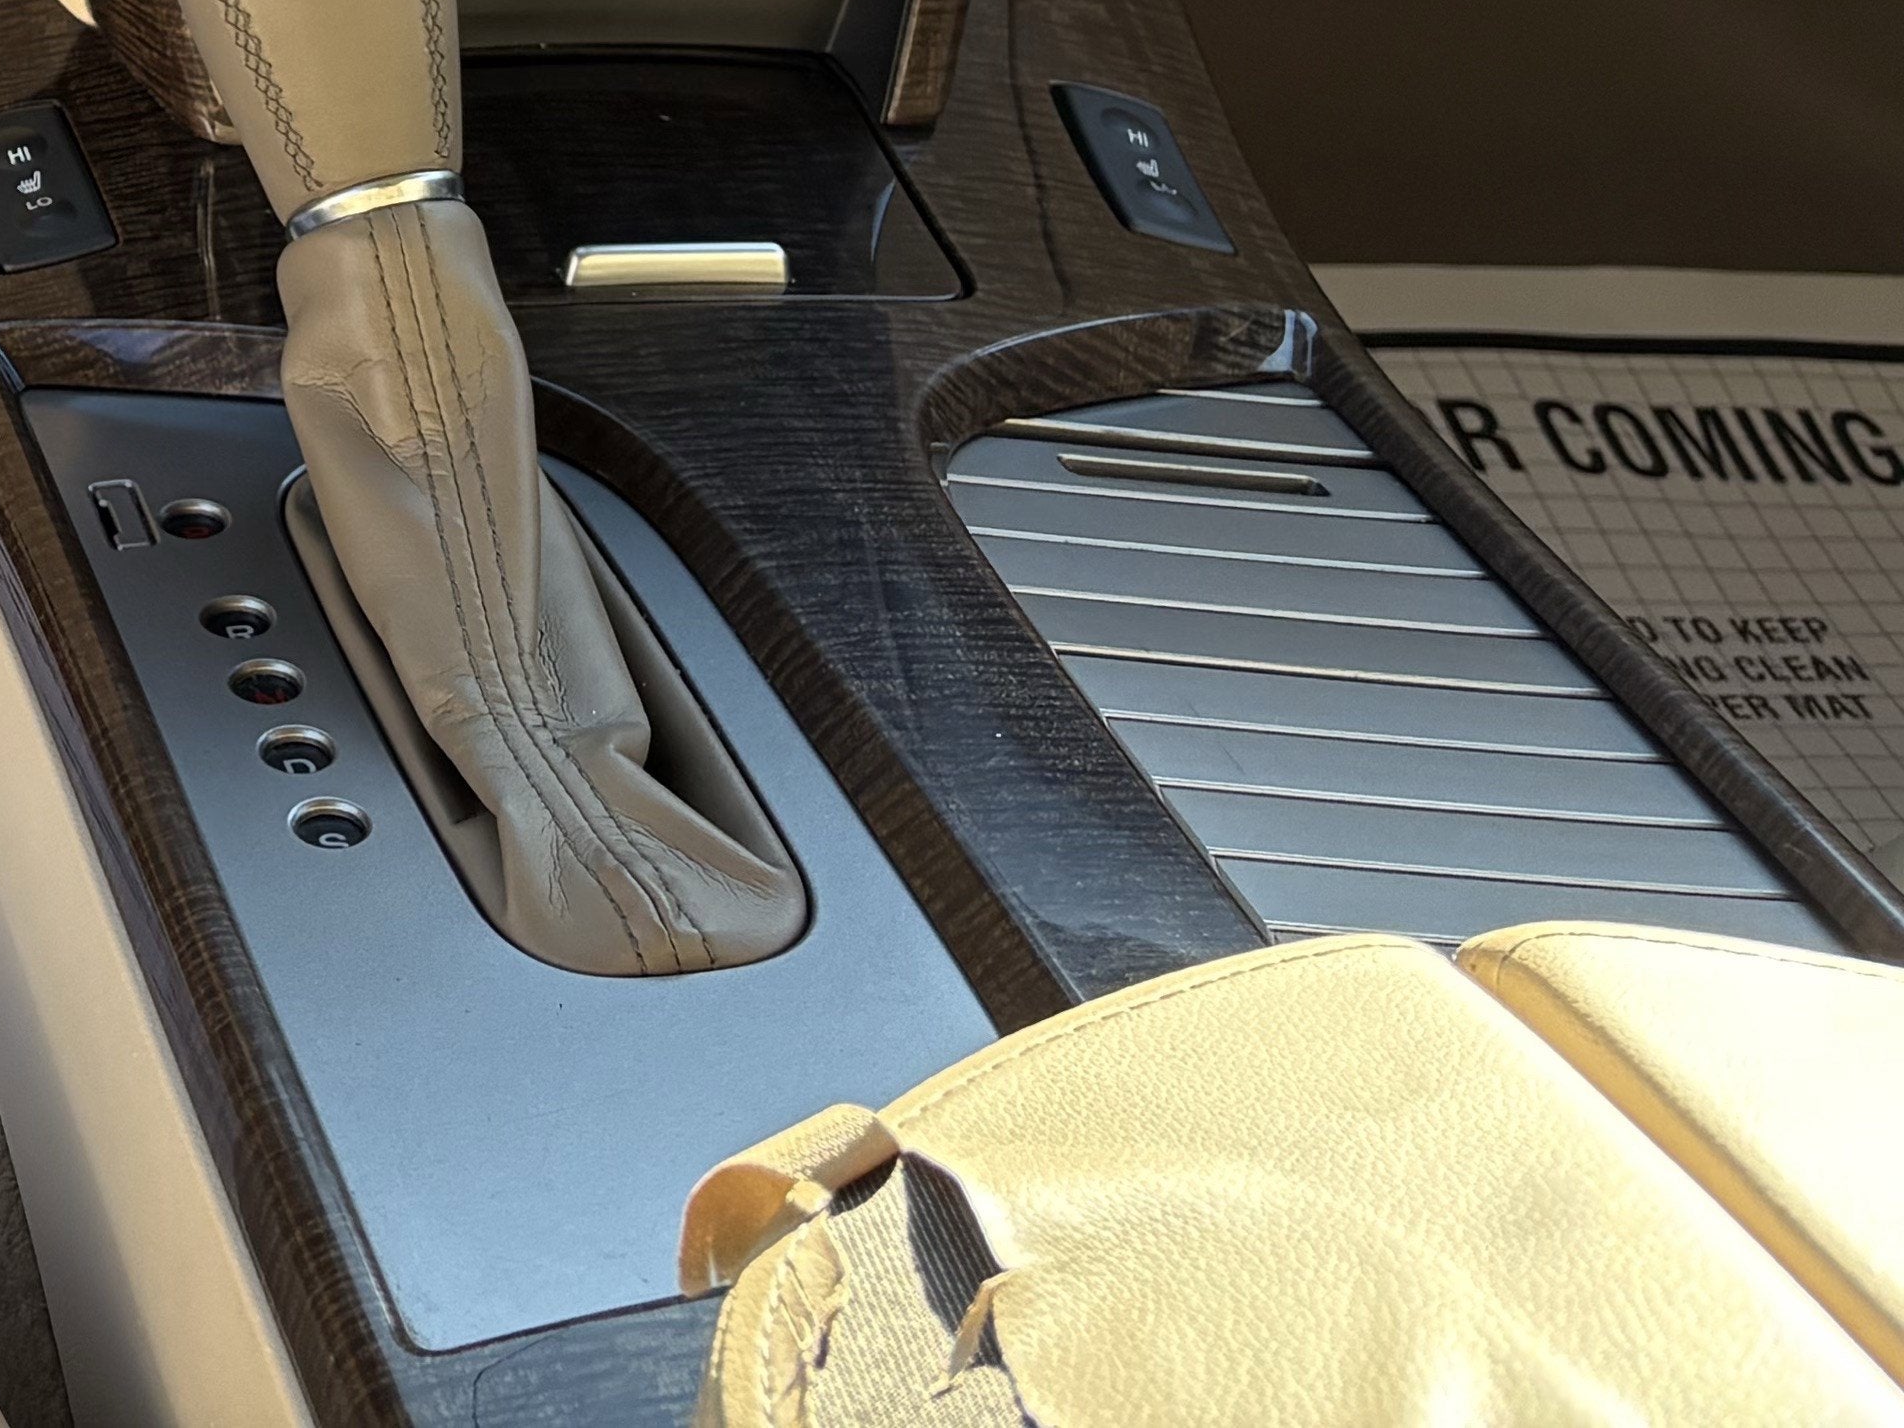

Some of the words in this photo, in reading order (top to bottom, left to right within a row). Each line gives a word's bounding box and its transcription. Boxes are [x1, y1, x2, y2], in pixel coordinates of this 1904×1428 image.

[1127, 128, 1149, 148] HI
[7, 146, 32, 166] HI
[26, 196, 53, 210] LO
[1533, 398, 1904, 486] COMING
[1663, 616, 1722, 643] TO
[1730, 616, 1828, 643] KEEP
[1734, 655, 1870, 682] CLEAN
[1784, 694, 1873, 720] MAT
